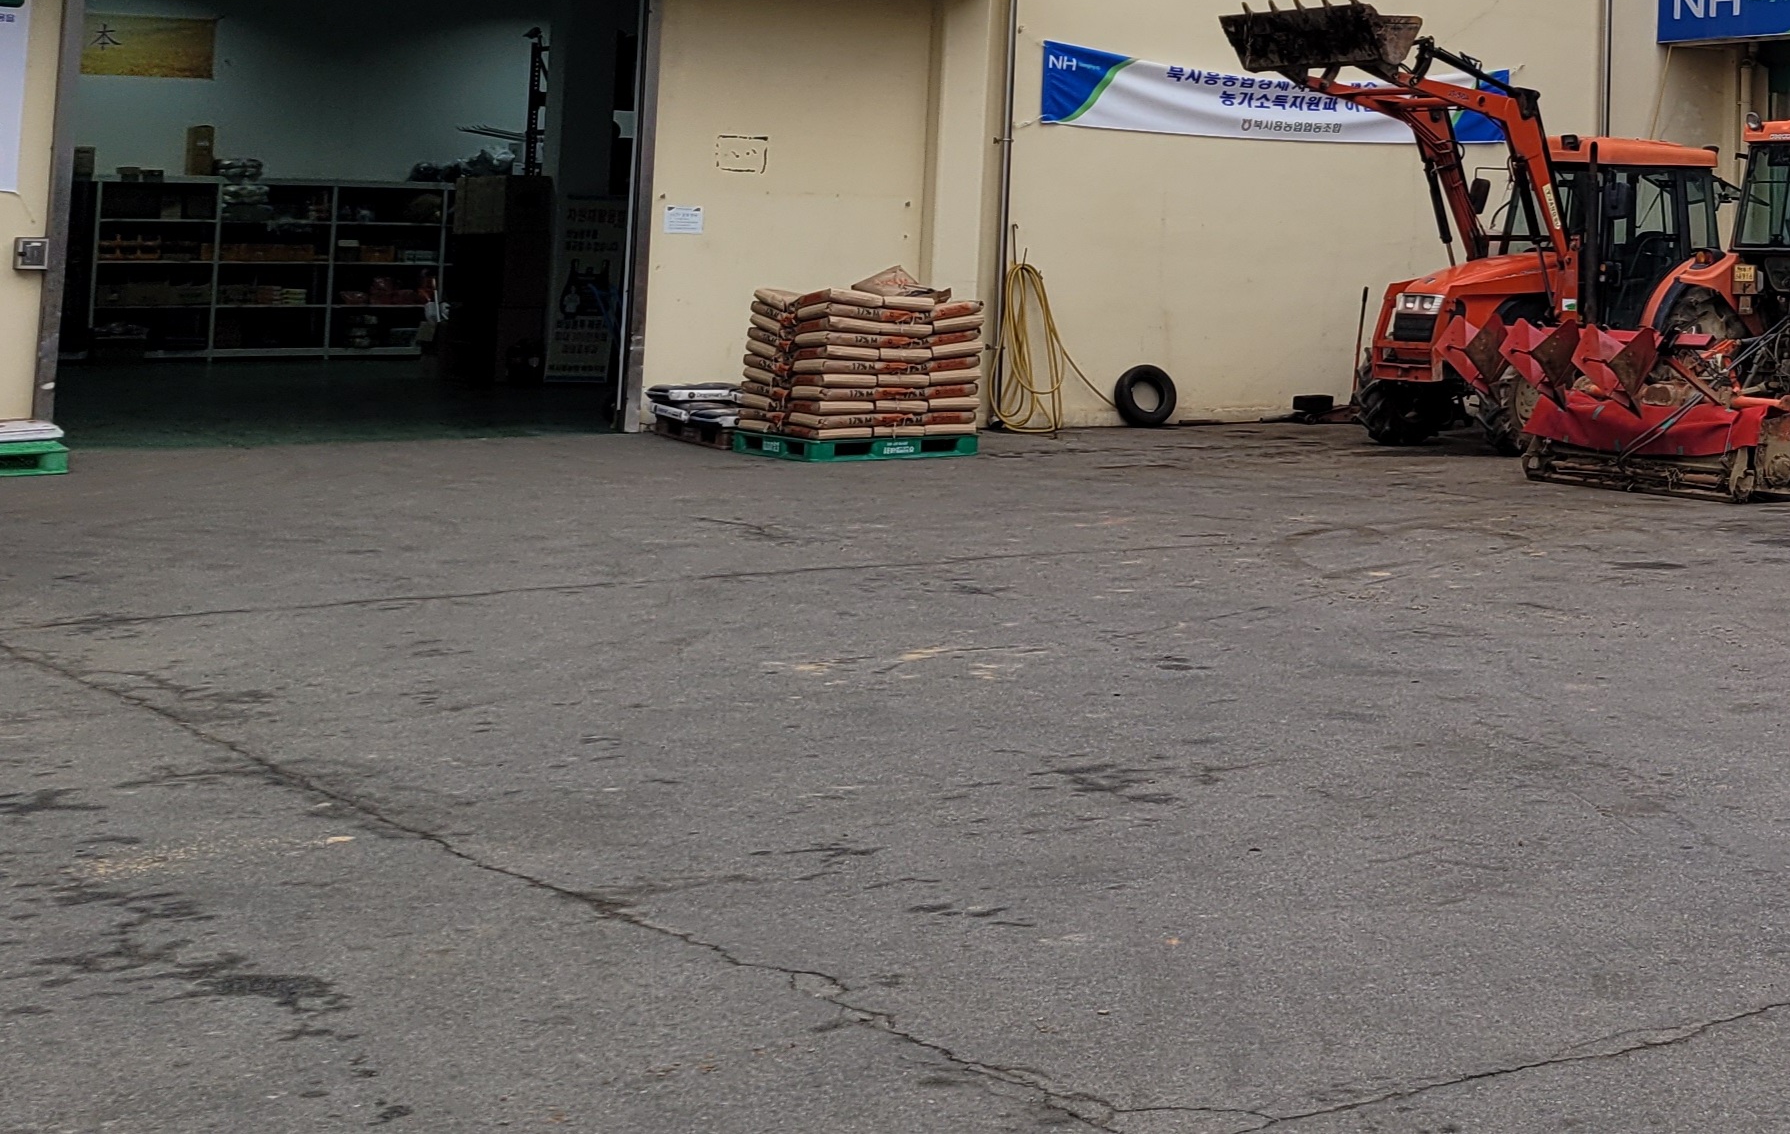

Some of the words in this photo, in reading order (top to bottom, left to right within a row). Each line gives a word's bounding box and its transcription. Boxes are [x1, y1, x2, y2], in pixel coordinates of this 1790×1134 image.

[1048, 54, 1077, 71] NH
[1219, 90, 1340, 113] 농가소득지원과
[1253, 120, 1342, 135] 북시흥농업협동조합
